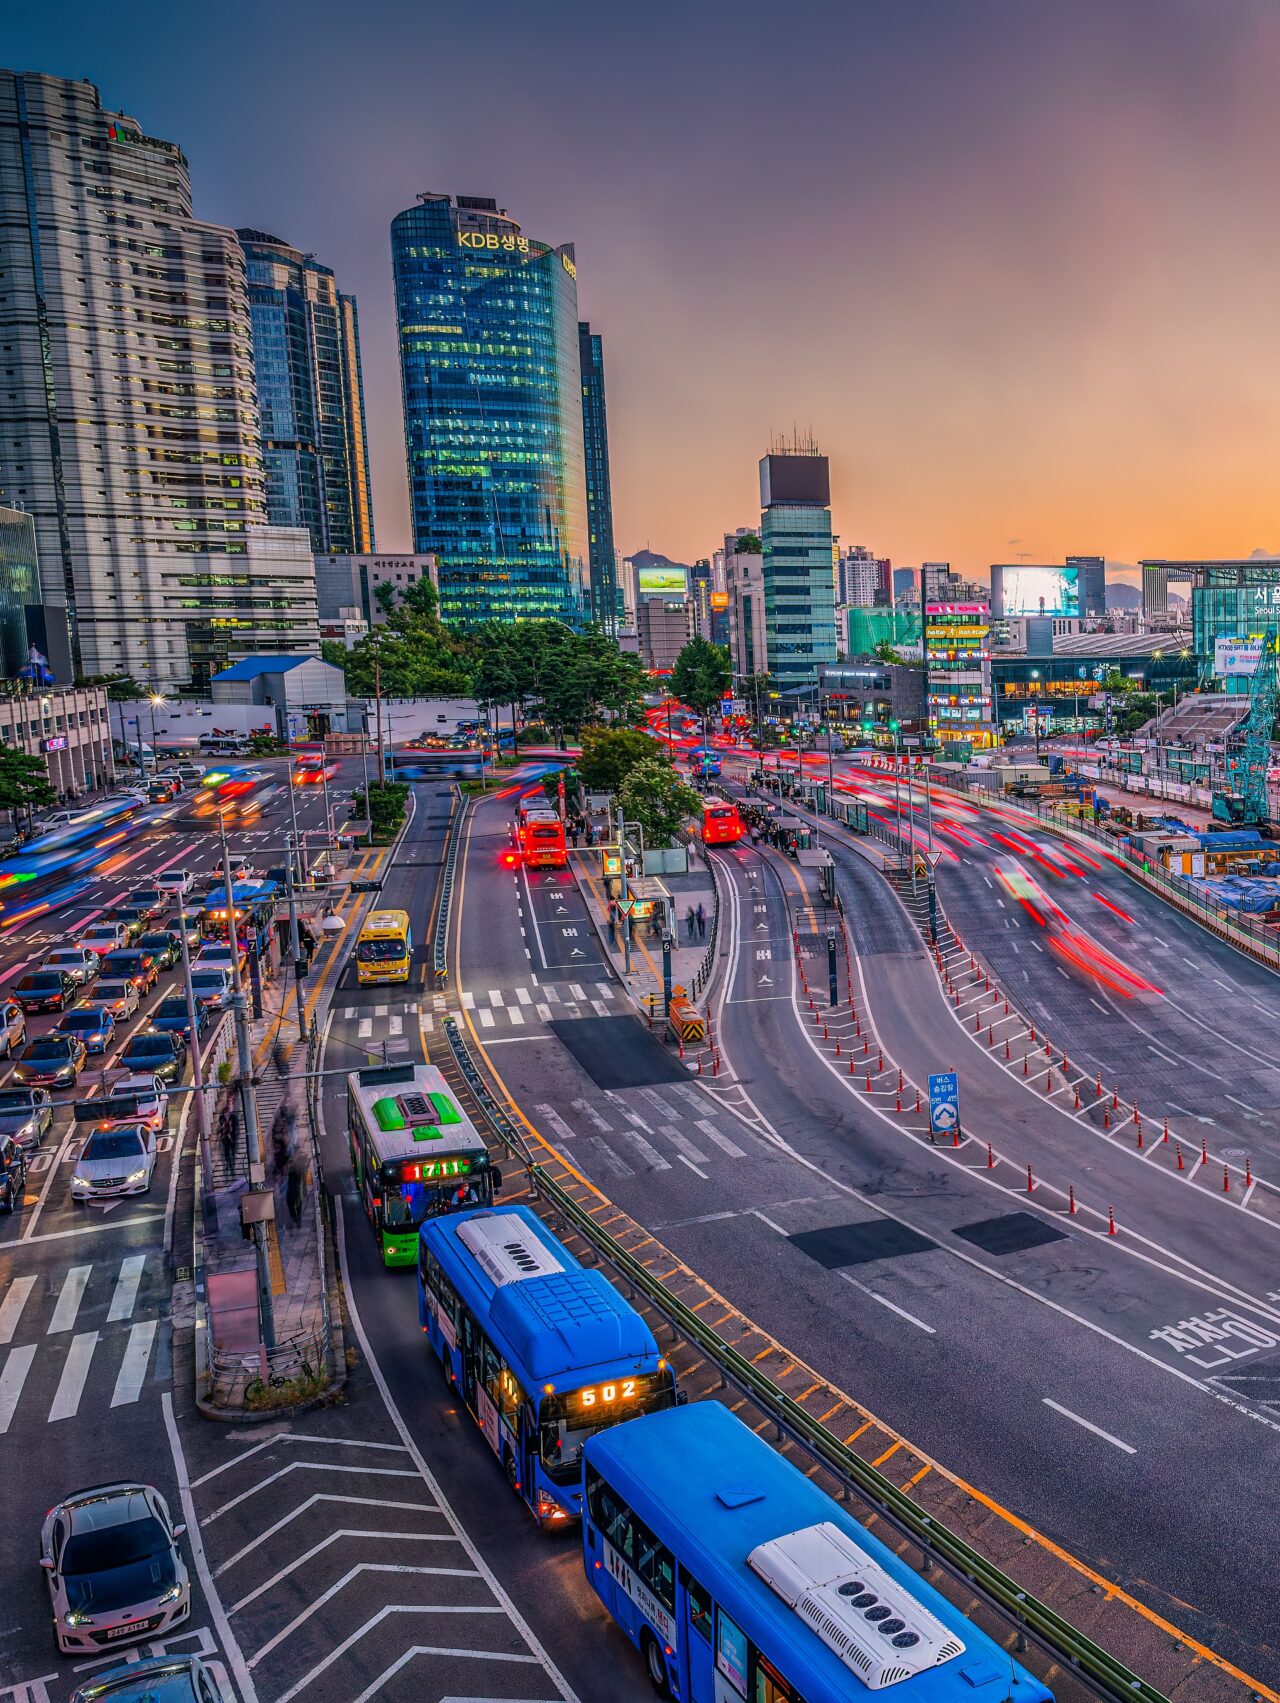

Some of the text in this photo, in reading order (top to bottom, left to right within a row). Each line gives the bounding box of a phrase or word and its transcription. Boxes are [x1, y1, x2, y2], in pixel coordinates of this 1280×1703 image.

[458, 231, 529, 252] KDB생명
[1254, 606, 1275, 615] Seoul
[250, 941, 256, 950] 7
[664, 941, 670, 951] 6
[829, 940, 835, 949] 5
[936, 1076, 951, 1084] 버스
[933, 1083, 955, 1094] 승강장
[931, 1094, 957, 1105] 5번 4번
[414, 1161, 460, 1179] 1711
[582, 1380, 637, 1407] 502
